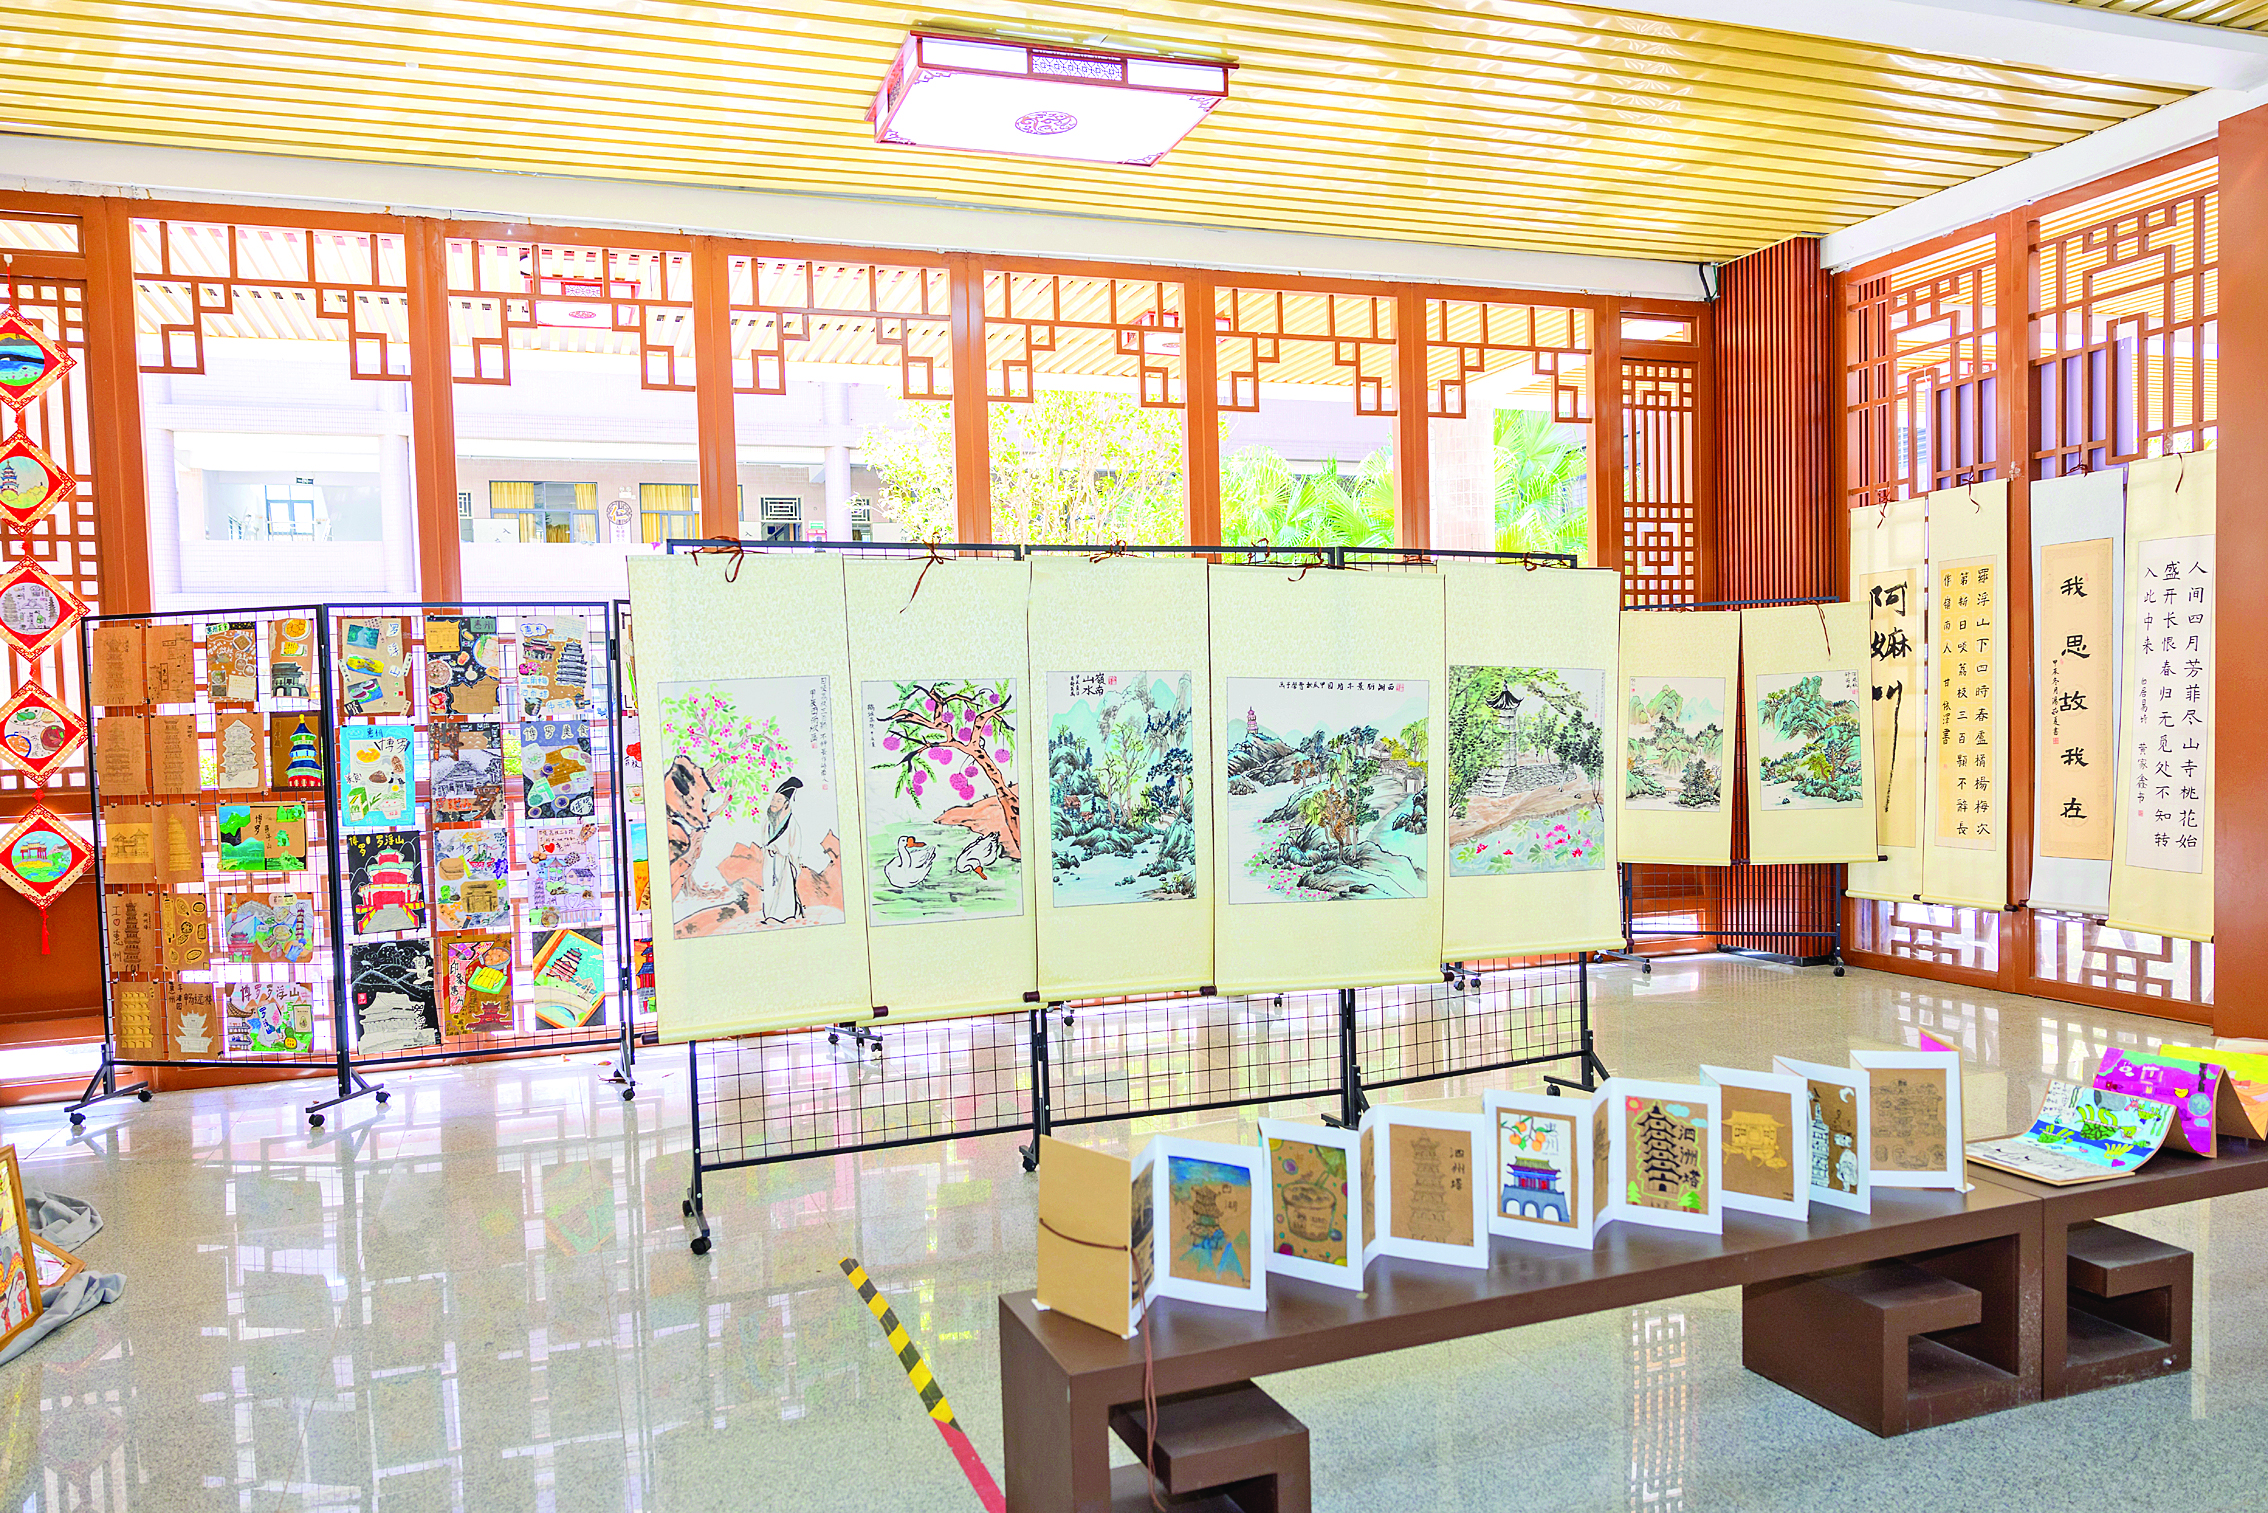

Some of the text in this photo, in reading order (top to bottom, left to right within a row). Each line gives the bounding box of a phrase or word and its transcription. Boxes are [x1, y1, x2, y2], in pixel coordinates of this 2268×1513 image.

[1081, 675, 1097, 696] 山水
[2059, 575, 2091, 820] 我思故我在
[2142, 566, 2159, 656] 入此中来
[2155, 560, 2181, 848] 盛开长恨春归无觅处不知转
[2175, 560, 2209, 850] 人间四月芳菲尽山寺桃花始
